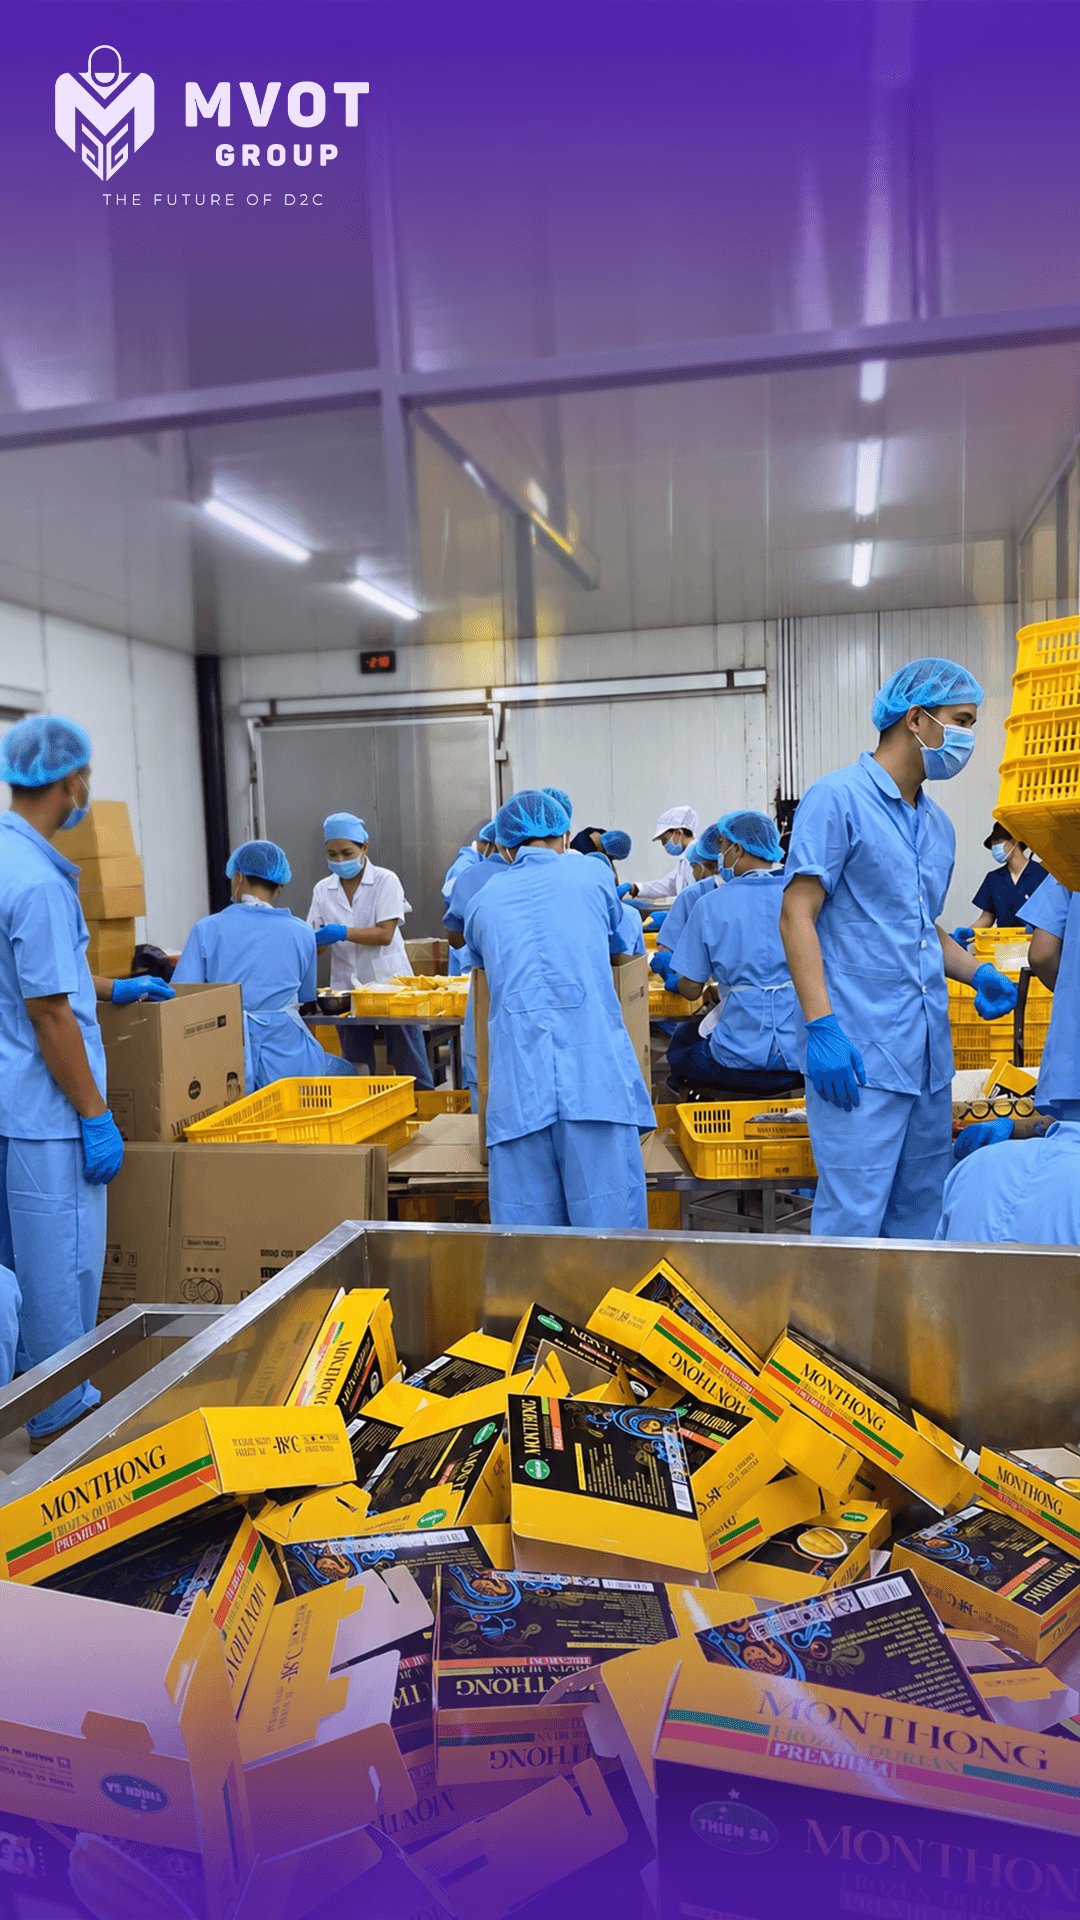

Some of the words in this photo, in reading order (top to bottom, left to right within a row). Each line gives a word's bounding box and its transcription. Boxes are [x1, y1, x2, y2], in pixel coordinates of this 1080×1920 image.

[800, 1363, 887, 1432] MONTHONG
[40, 1445, 167, 1527] MONTHONG
[997, 1465, 1063, 1515] MONTHONG
[757, 1690, 1048, 1771] MONTHONG
[749, 1827, 770, 1843] SA
